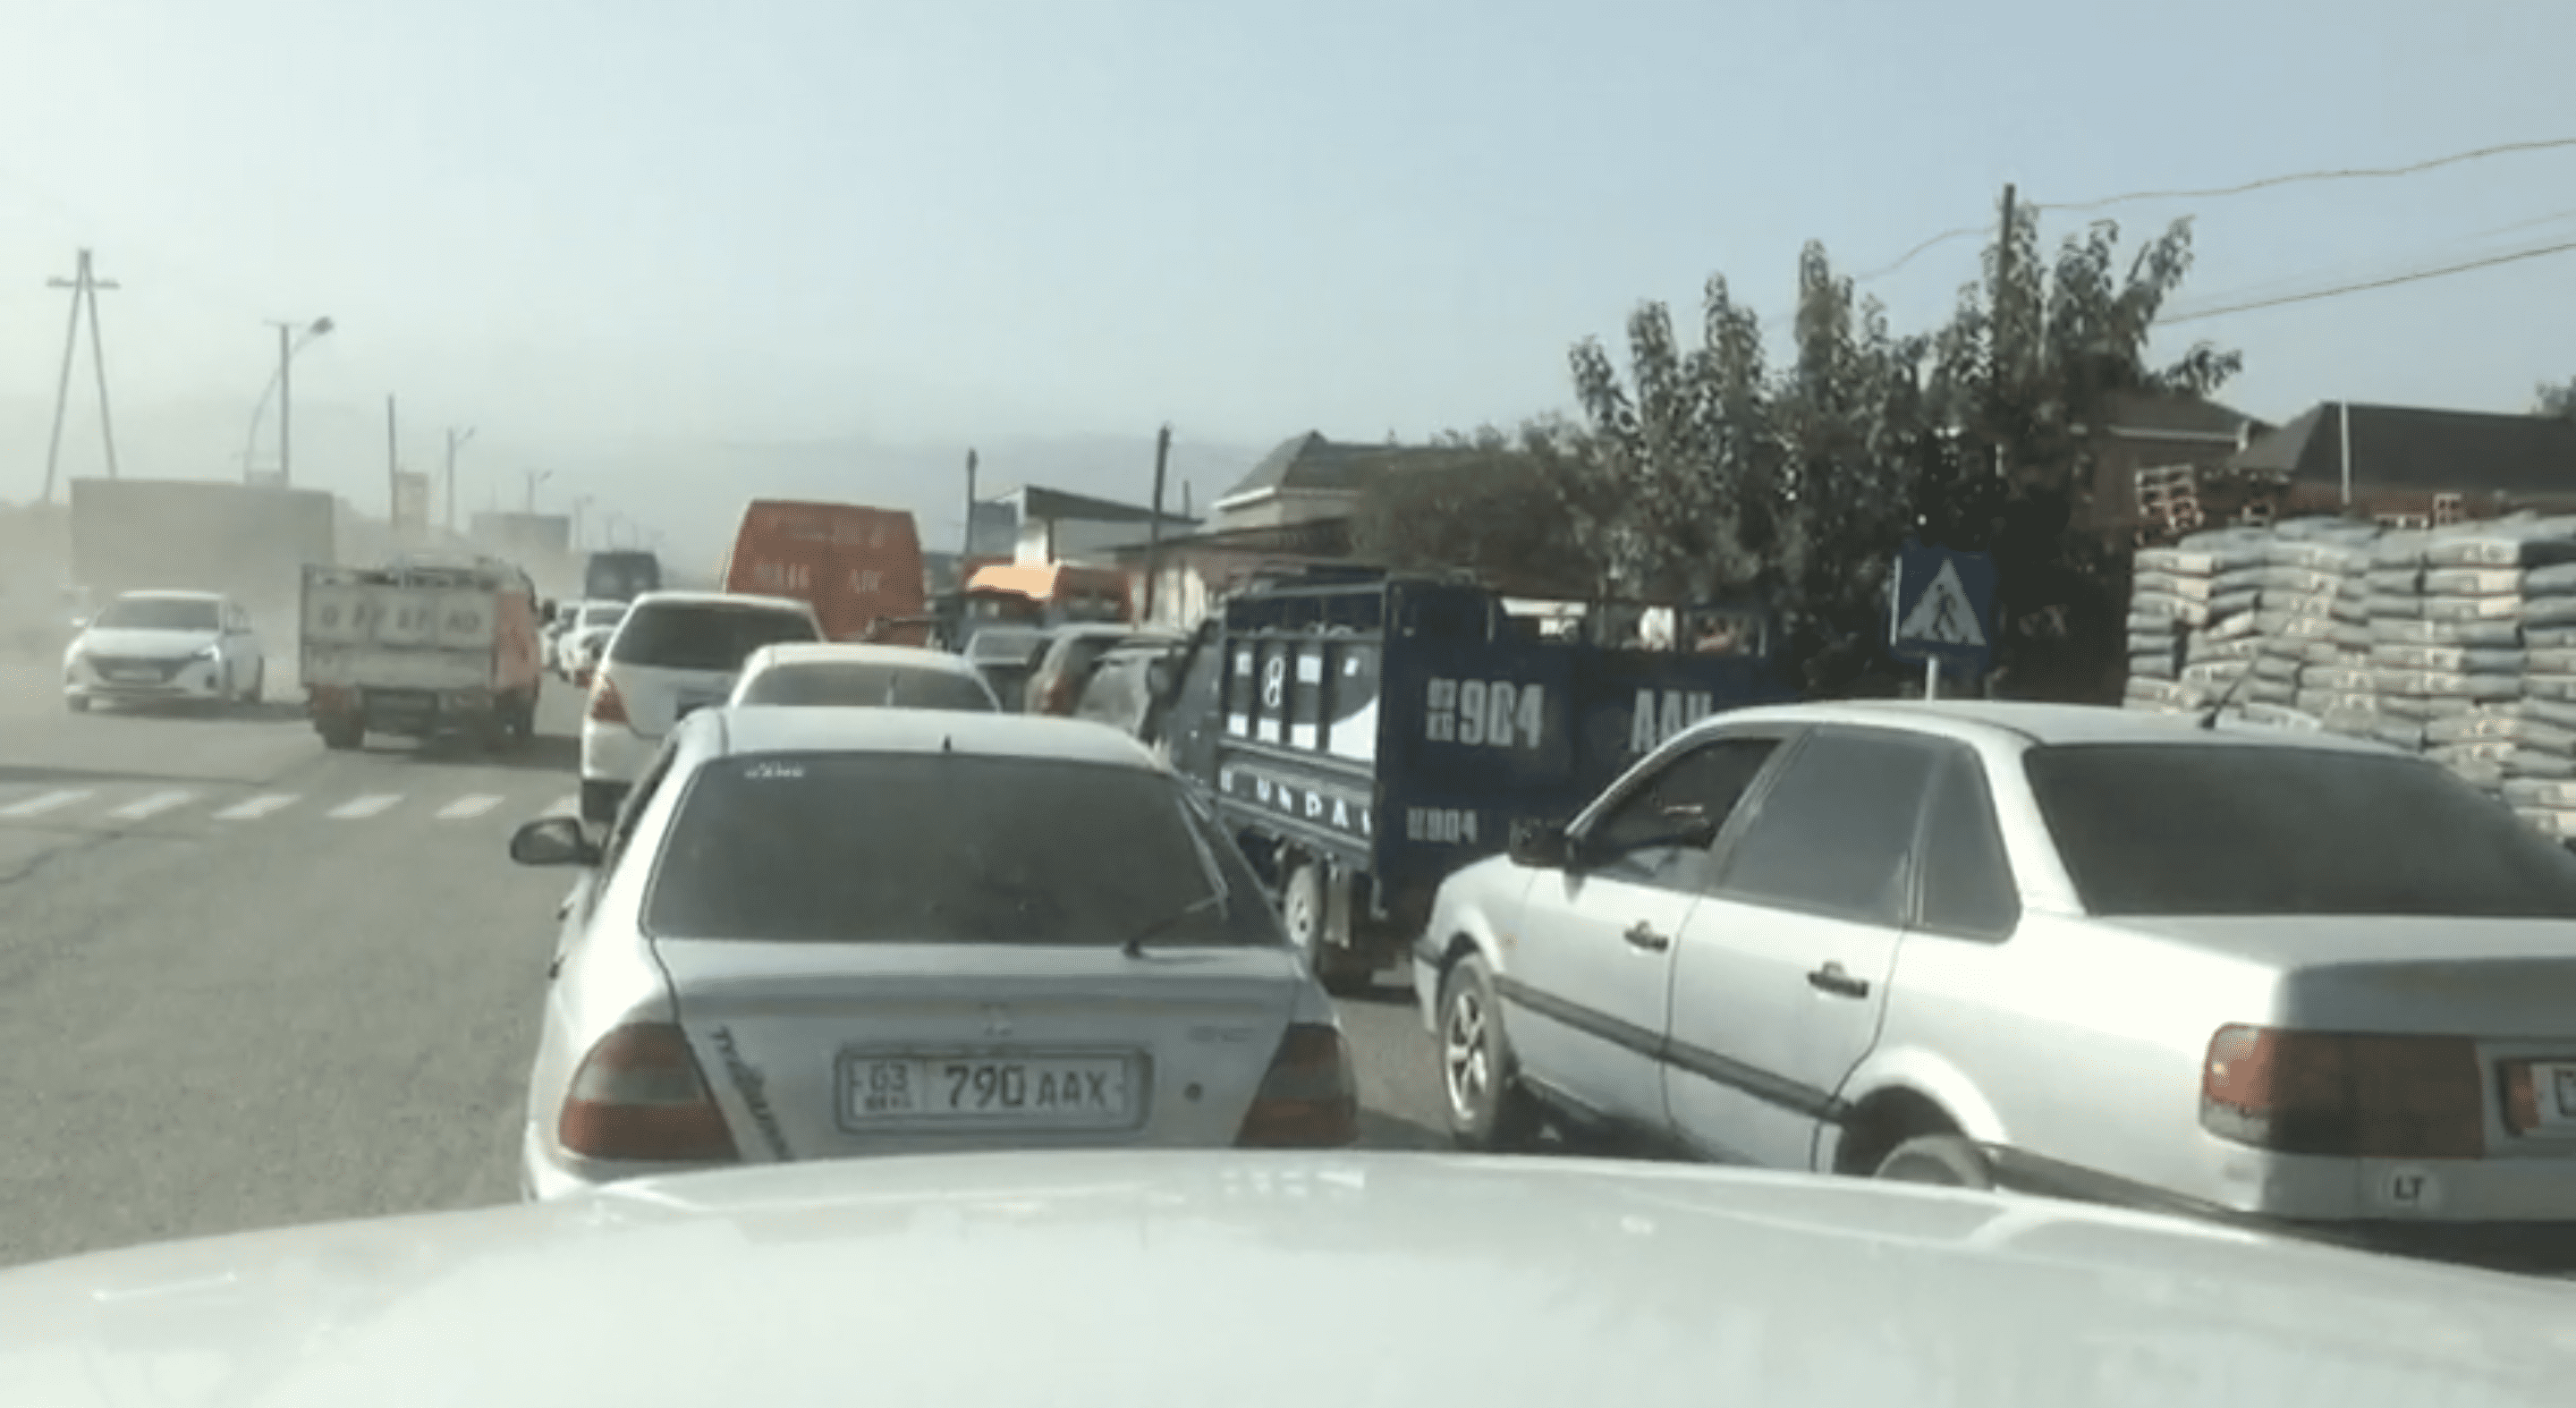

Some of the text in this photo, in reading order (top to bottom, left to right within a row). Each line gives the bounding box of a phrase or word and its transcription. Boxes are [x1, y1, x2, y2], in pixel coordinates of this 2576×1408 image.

[869, 1064, 1106, 1108] 03 790 AAX
[2394, 1175, 2425, 1200] LT
